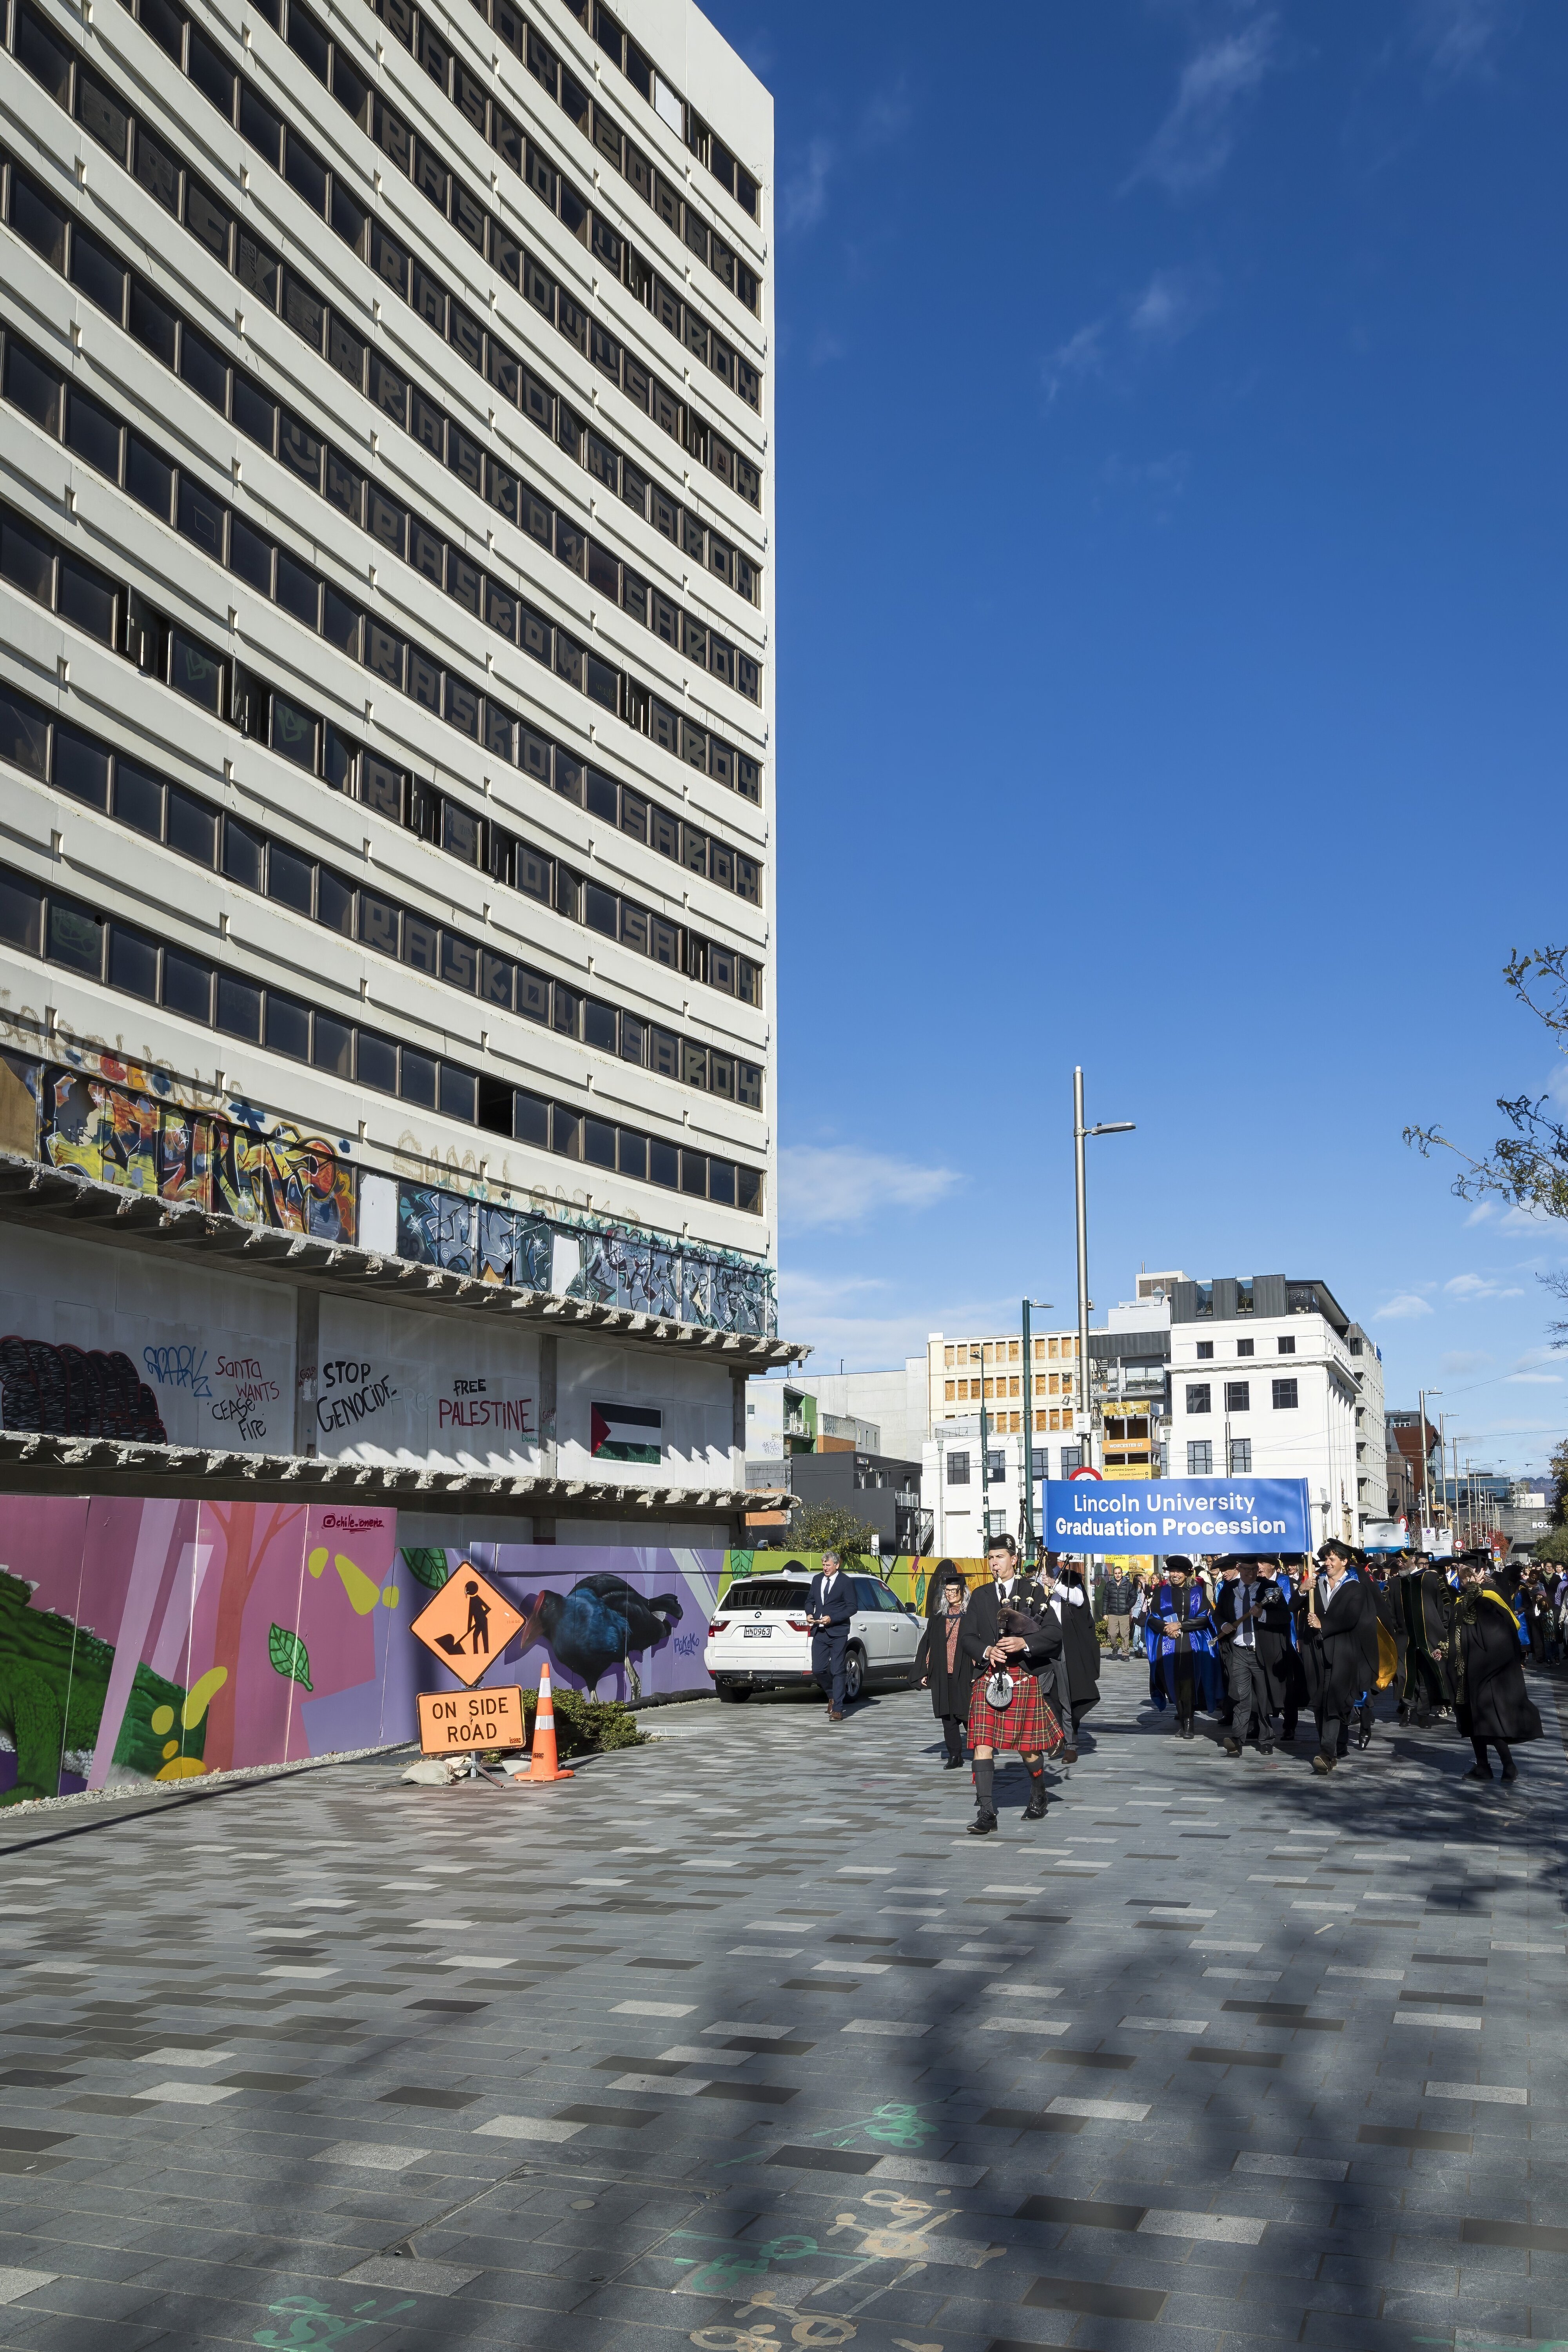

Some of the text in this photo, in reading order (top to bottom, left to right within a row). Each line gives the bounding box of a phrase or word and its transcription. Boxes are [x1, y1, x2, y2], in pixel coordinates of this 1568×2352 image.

[323, 1361, 371, 1388] STOP
[236, 1381, 280, 1402] WANTS
[453, 1379, 486, 1397] FREE
[1074, 1492, 1255, 1514] Lincoln University
[1056, 1516, 1286, 1536] Graduation Procession
[745, 1627, 770, 1635] HND963
[432, 1697, 509, 1719] ON SIDE
[448, 1723, 497, 1743] ROAD
